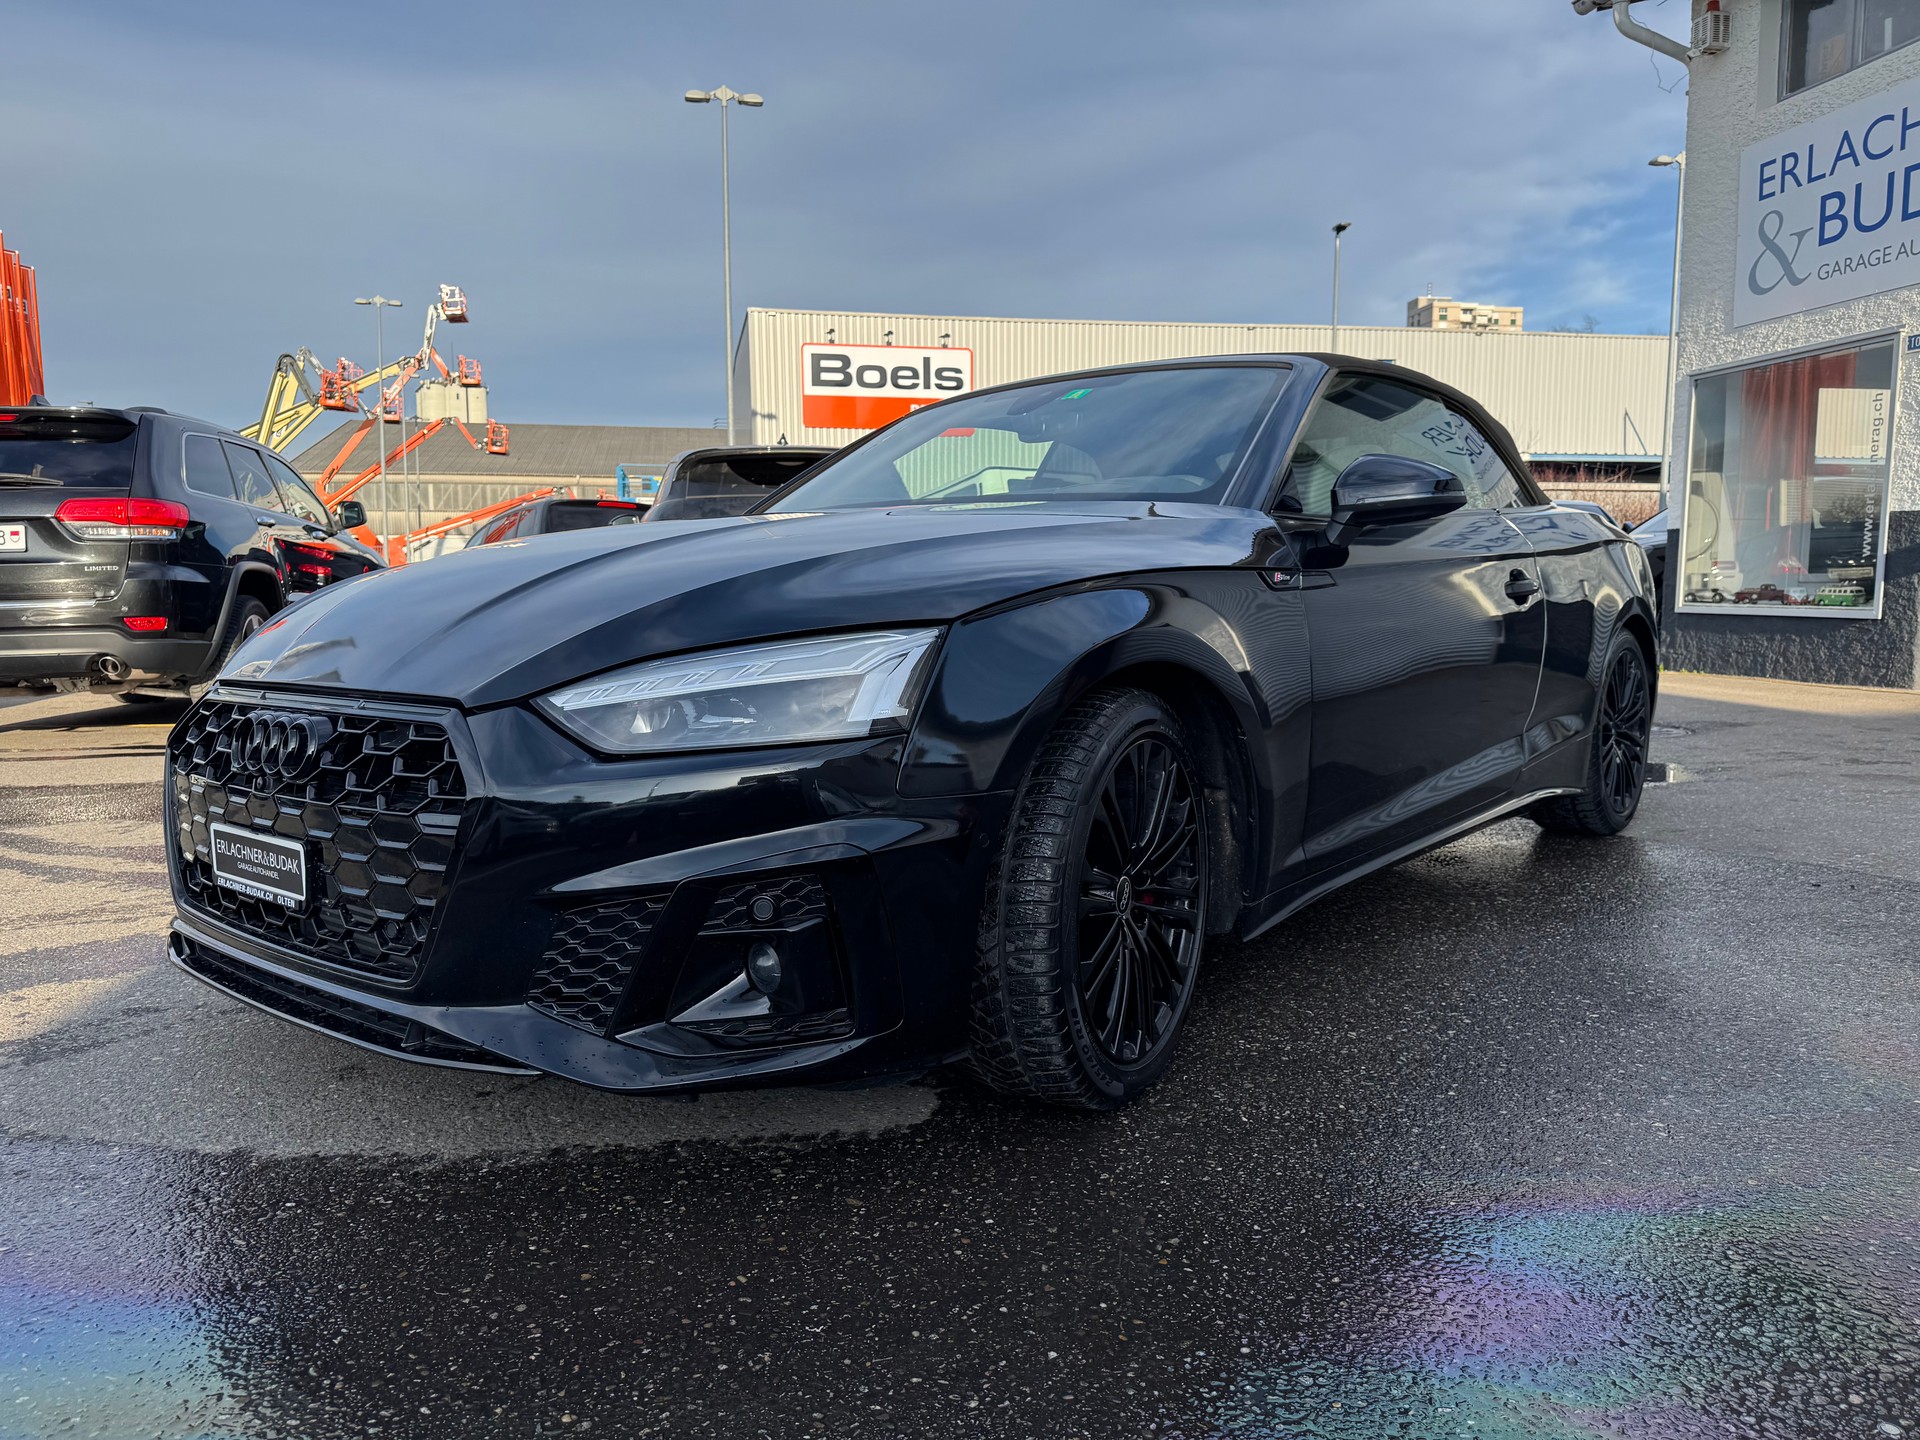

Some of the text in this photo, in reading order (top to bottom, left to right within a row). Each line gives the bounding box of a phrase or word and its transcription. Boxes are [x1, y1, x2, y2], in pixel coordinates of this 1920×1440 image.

[1758, 106, 1920, 202] ERLACH
[1748, 209, 1814, 296] &
[1816, 245, 1892, 281] GARAGE
[811, 353, 964, 391] Boels
[1862, 392, 1884, 557] www.erlanerag.ch
[277, 895, 296, 908] OLTEN
